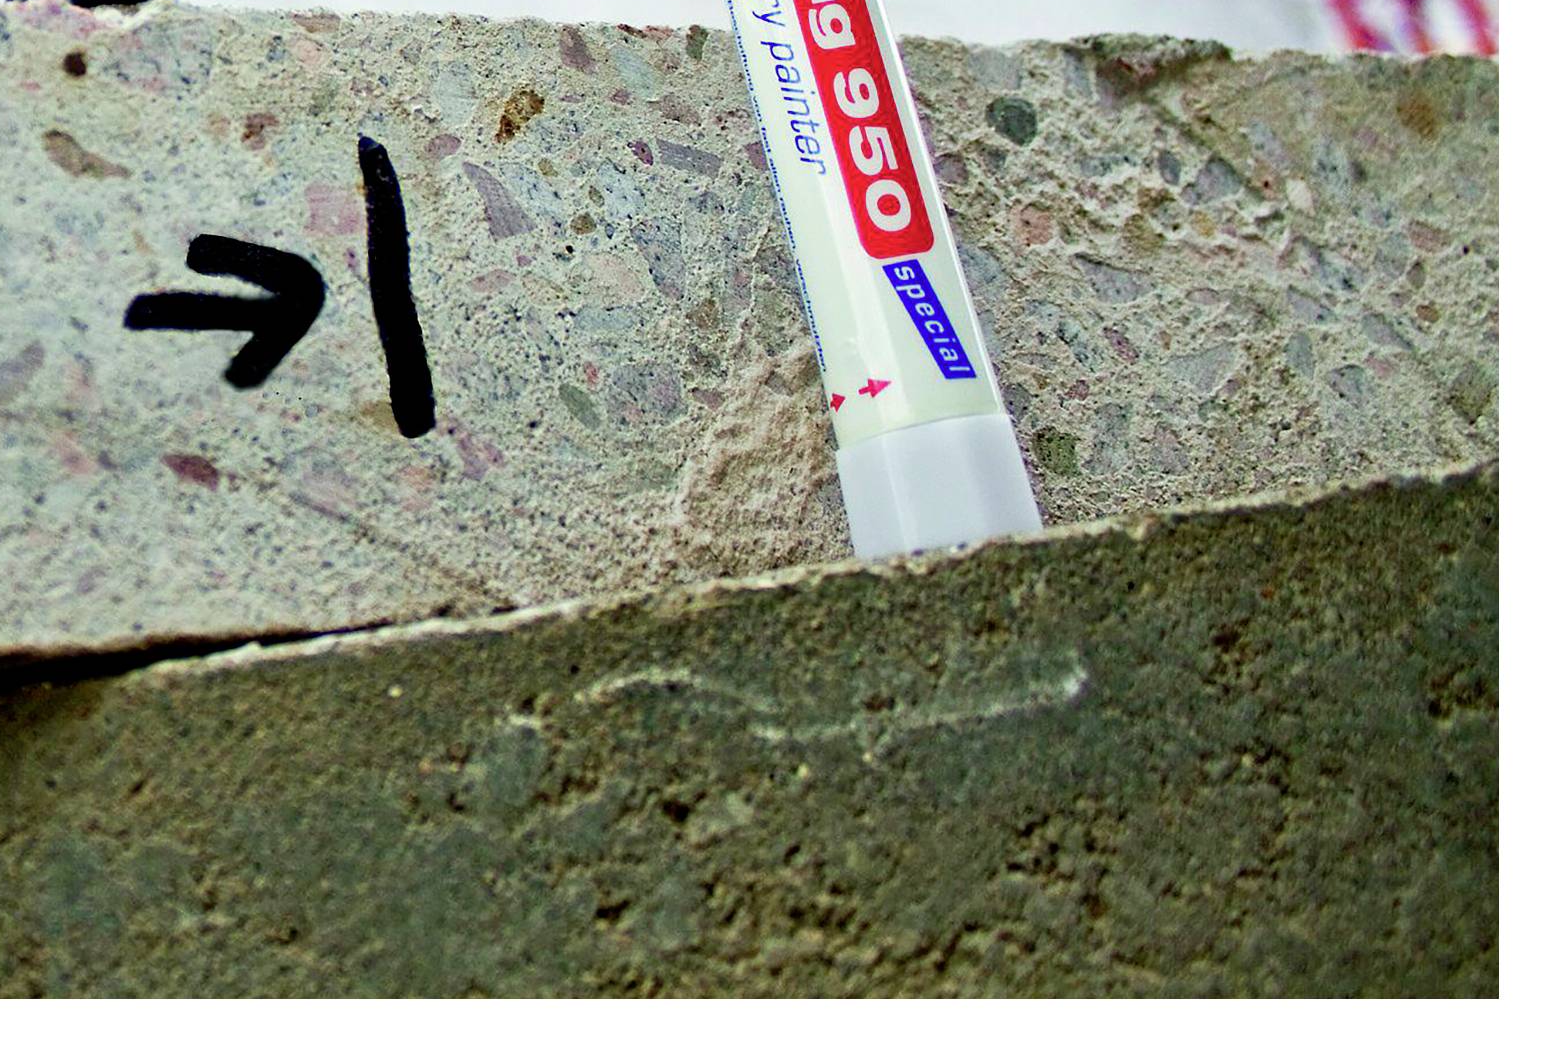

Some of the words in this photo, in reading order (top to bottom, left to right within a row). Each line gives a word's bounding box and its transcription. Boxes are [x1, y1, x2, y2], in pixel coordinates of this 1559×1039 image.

[760, 40, 826, 175] painter
[833, 67, 912, 232] 950
[893, 264, 971, 373] special
